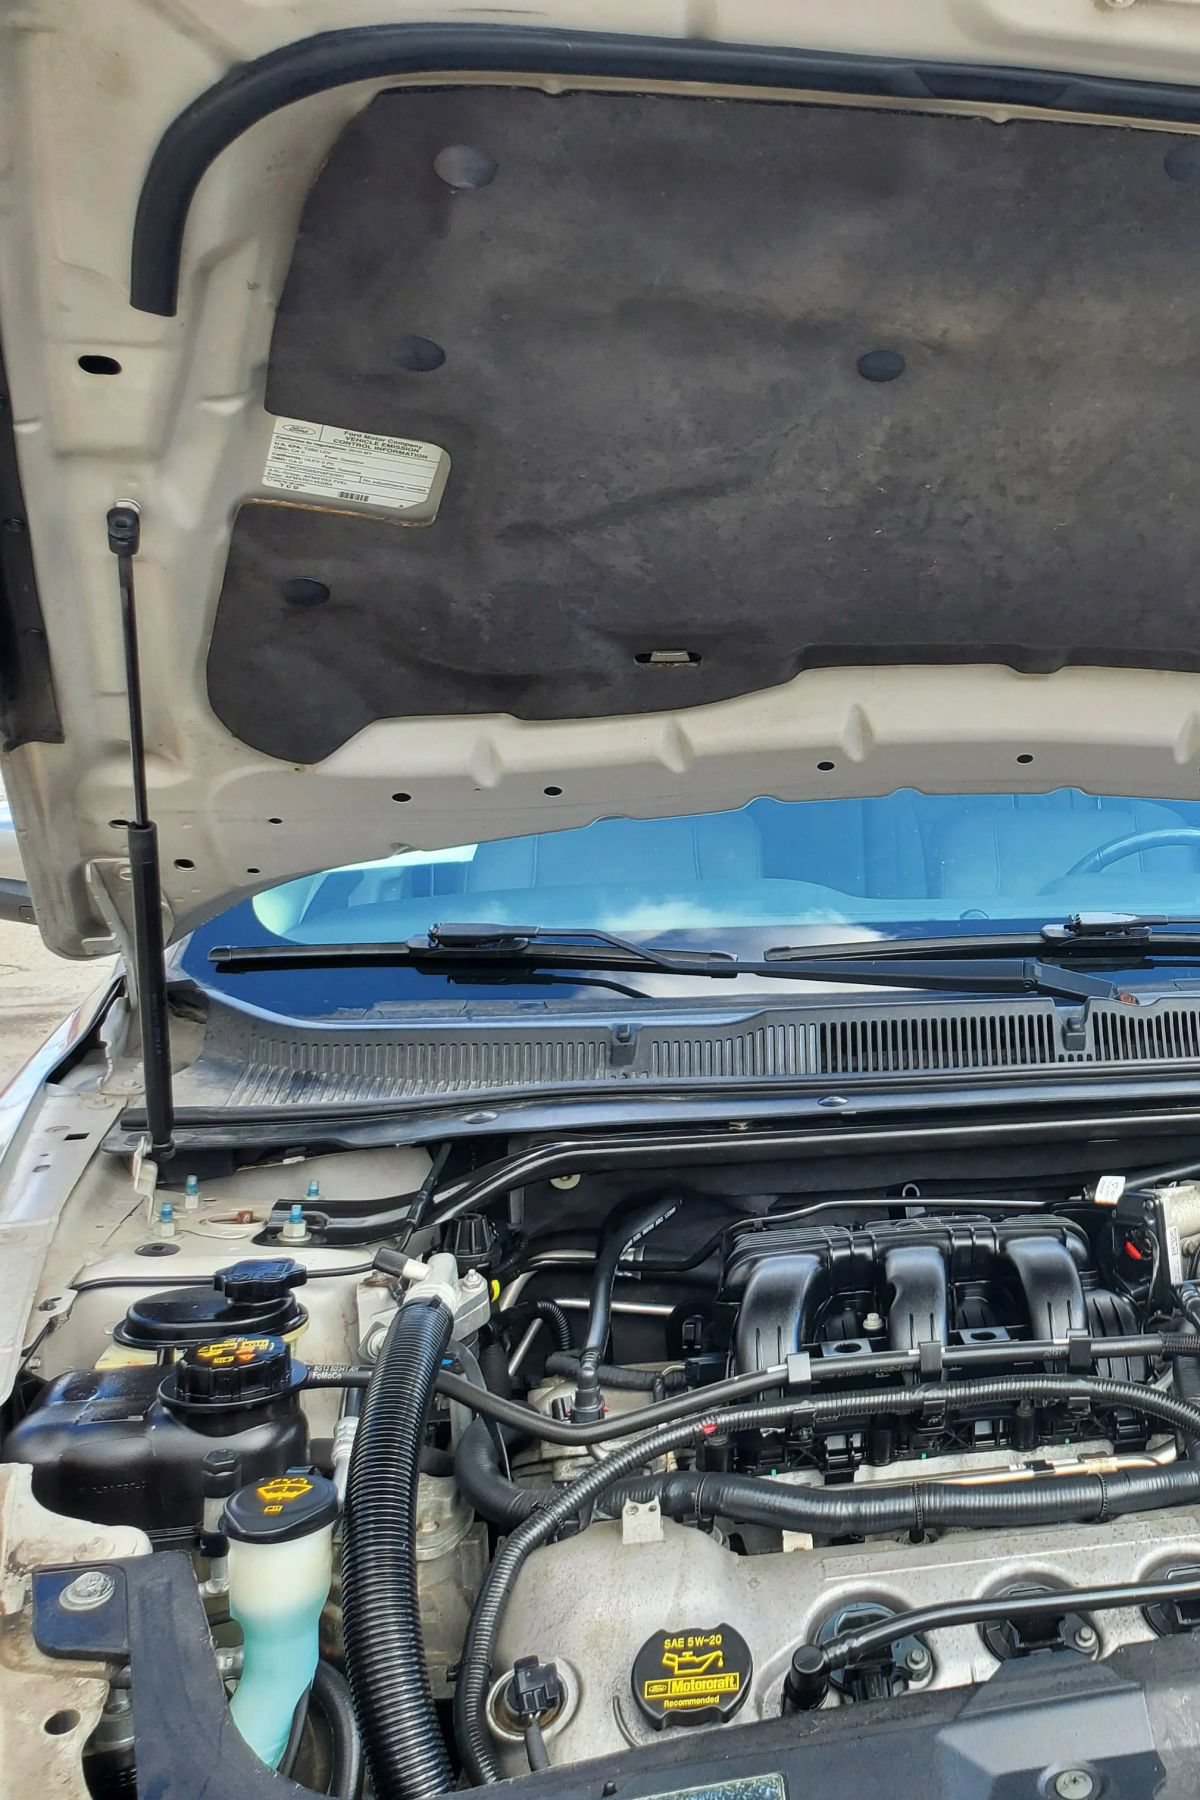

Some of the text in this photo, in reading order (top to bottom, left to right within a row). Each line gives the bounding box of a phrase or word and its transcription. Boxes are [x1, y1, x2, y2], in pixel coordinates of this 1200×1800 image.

[344, 430, 423, 450] Ford Motor Company
[345, 436, 420, 453] VEHICLE EMISSION
[333, 439, 428, 459] CONTROL INFORMATION
[312, 1371, 342, 1380] FoMoCo
[663, 1634, 723, 1649] SAE 5W-20
[671, 1674, 736, 1693] Motorcraft
[663, 1695, 720, 1708] Recommended
